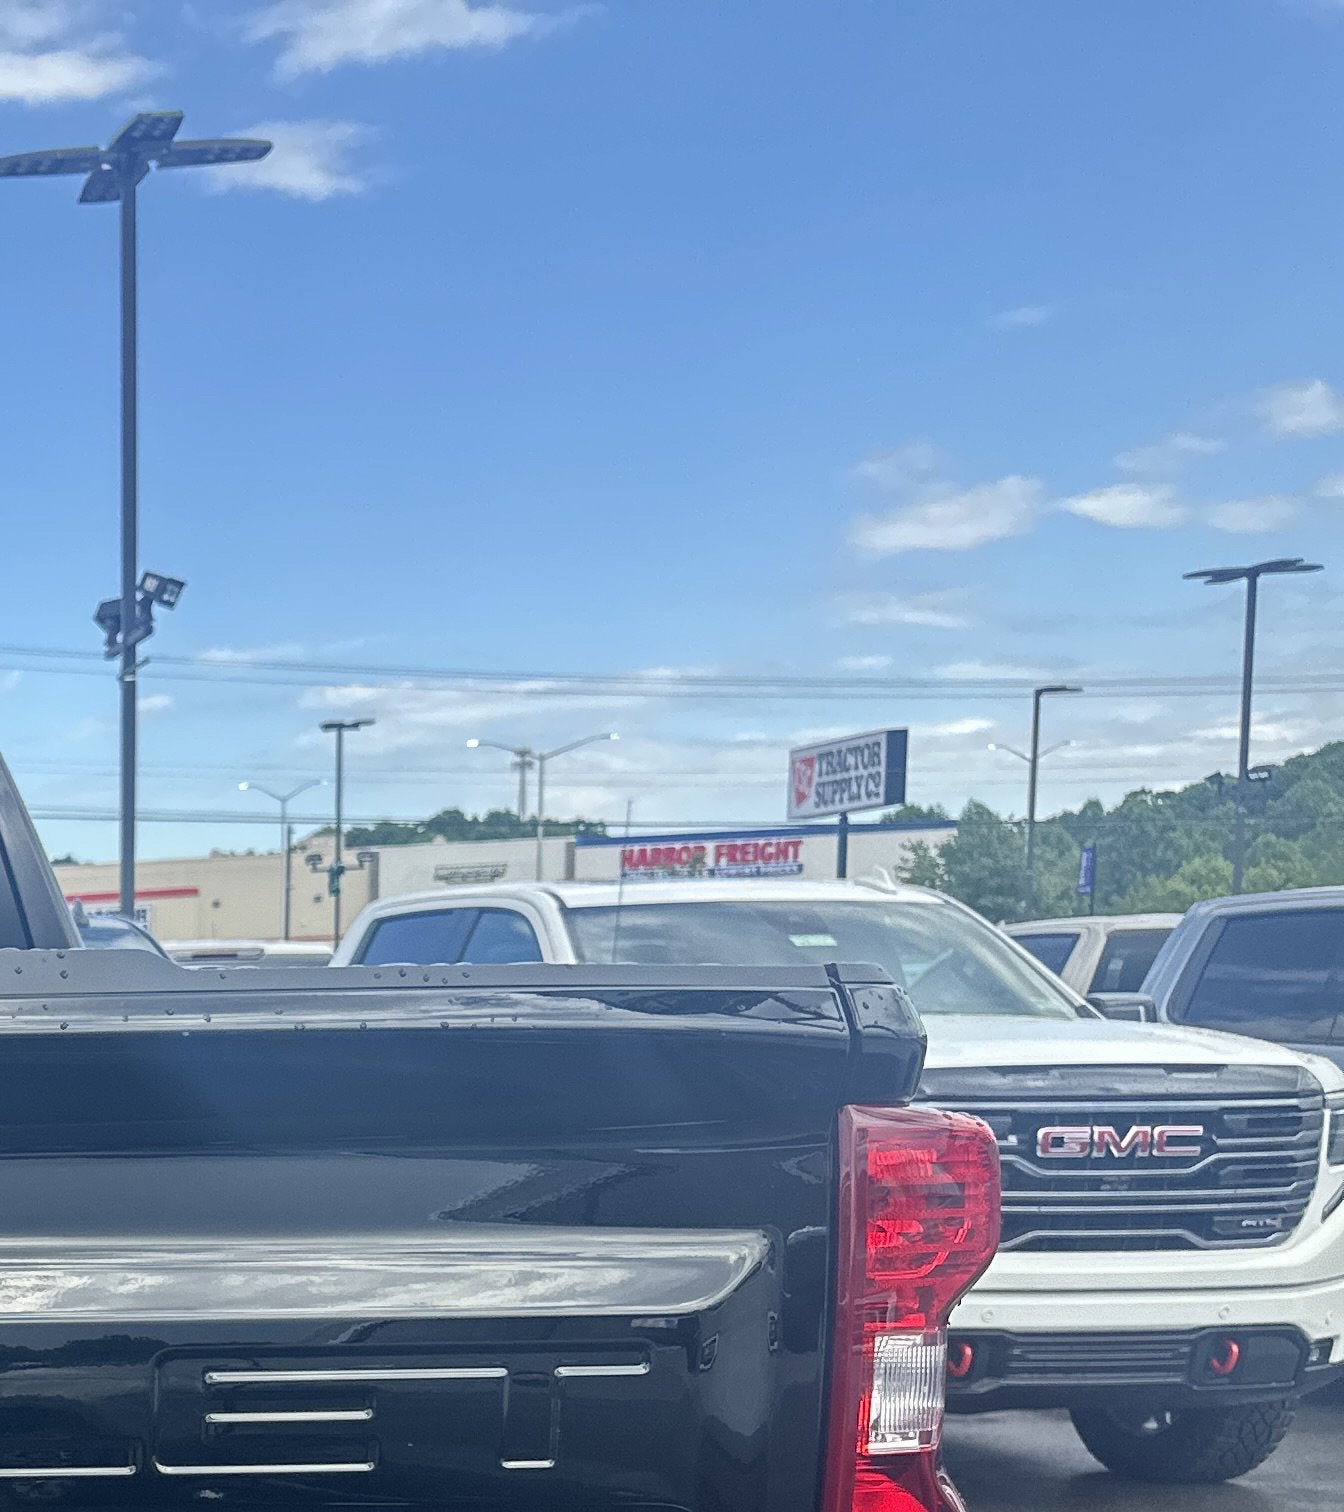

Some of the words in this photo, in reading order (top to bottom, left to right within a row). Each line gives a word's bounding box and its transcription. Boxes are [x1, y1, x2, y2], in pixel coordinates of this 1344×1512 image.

[816, 741, 882, 778] TRACTOR
[814, 775, 864, 808] SUPPLY
[623, 845, 706, 871] HARBOR
[714, 840, 803, 864] FREIGHT
[1036, 1124, 1204, 1159] GMC
